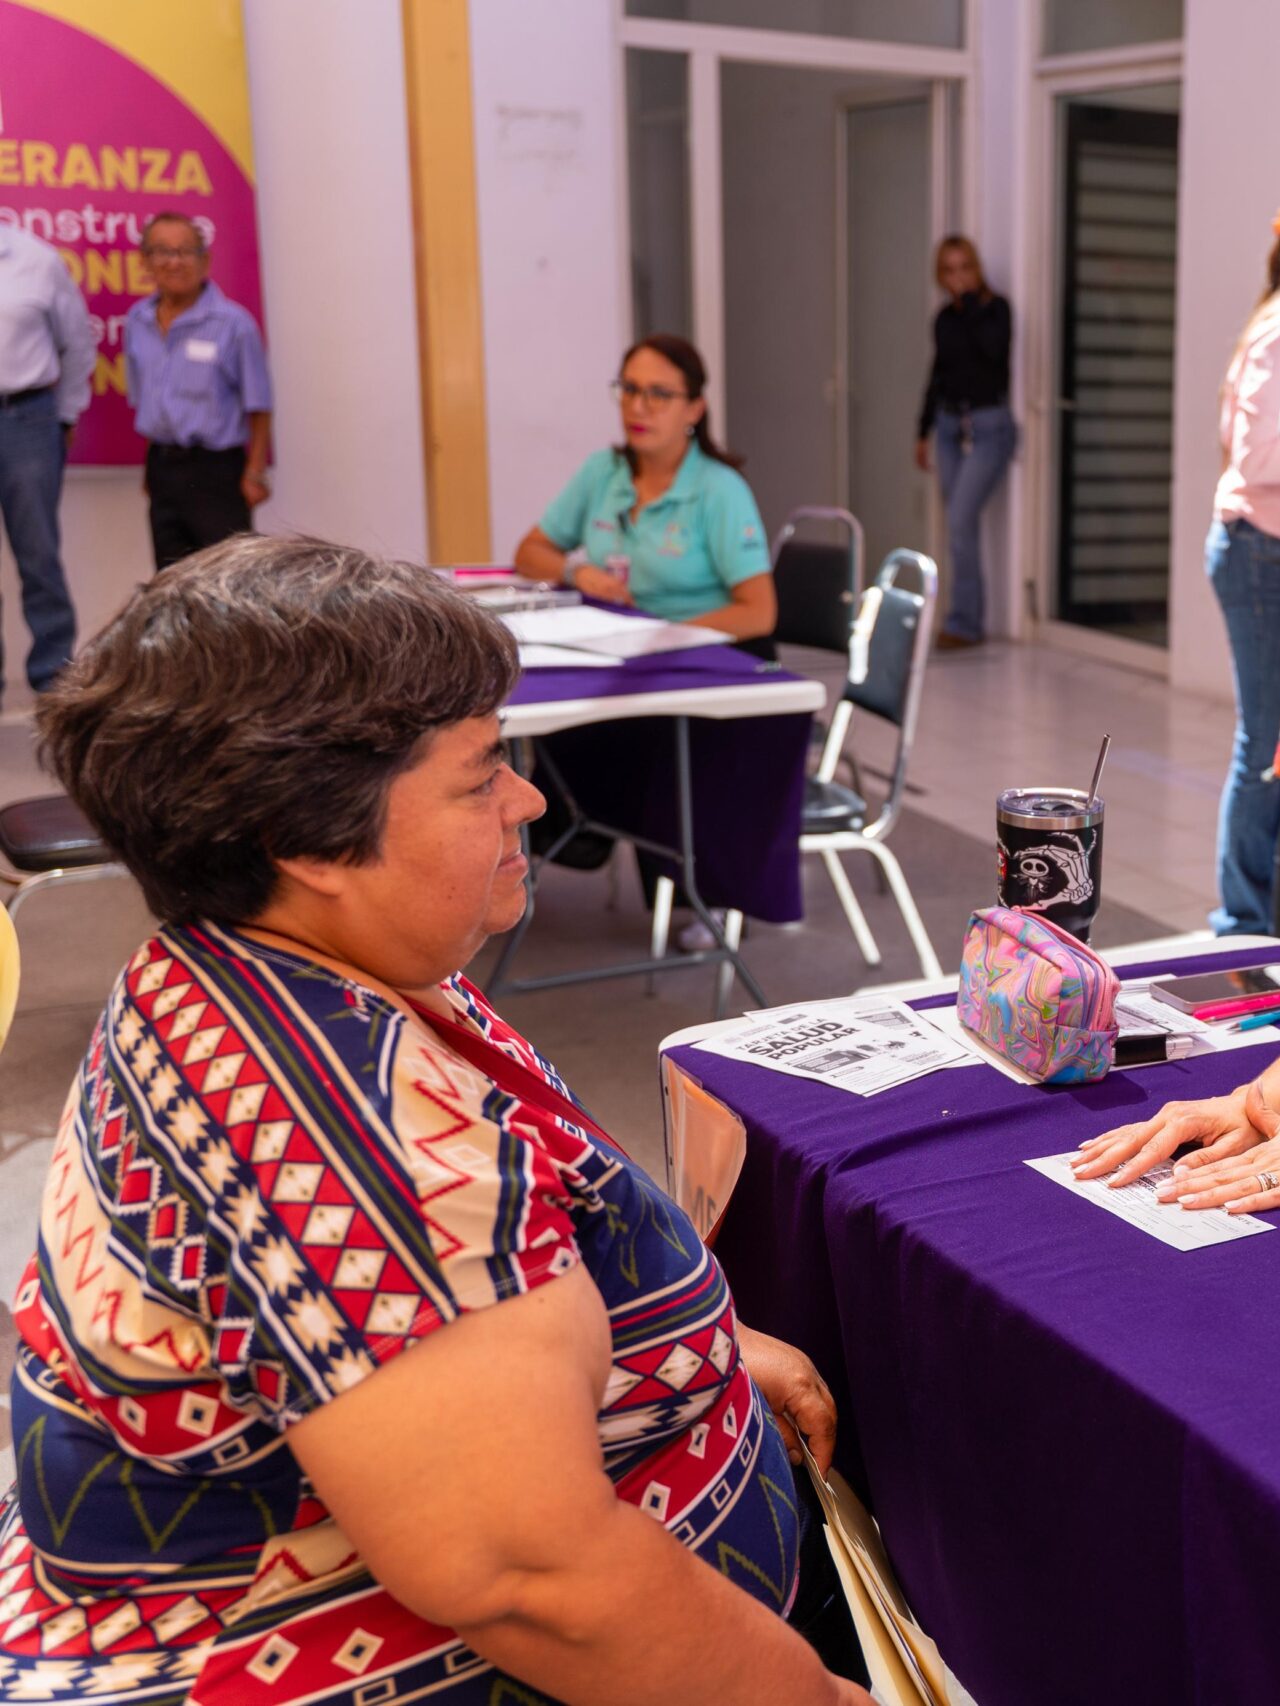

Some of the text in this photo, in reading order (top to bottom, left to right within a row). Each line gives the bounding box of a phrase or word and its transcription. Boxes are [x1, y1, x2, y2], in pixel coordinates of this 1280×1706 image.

[736, 1030, 790, 1051] TARJETA
[790, 1023, 810, 1031] DE
[748, 1022, 844, 1056] SALUD
[767, 1027, 861, 1060] POPULAR
